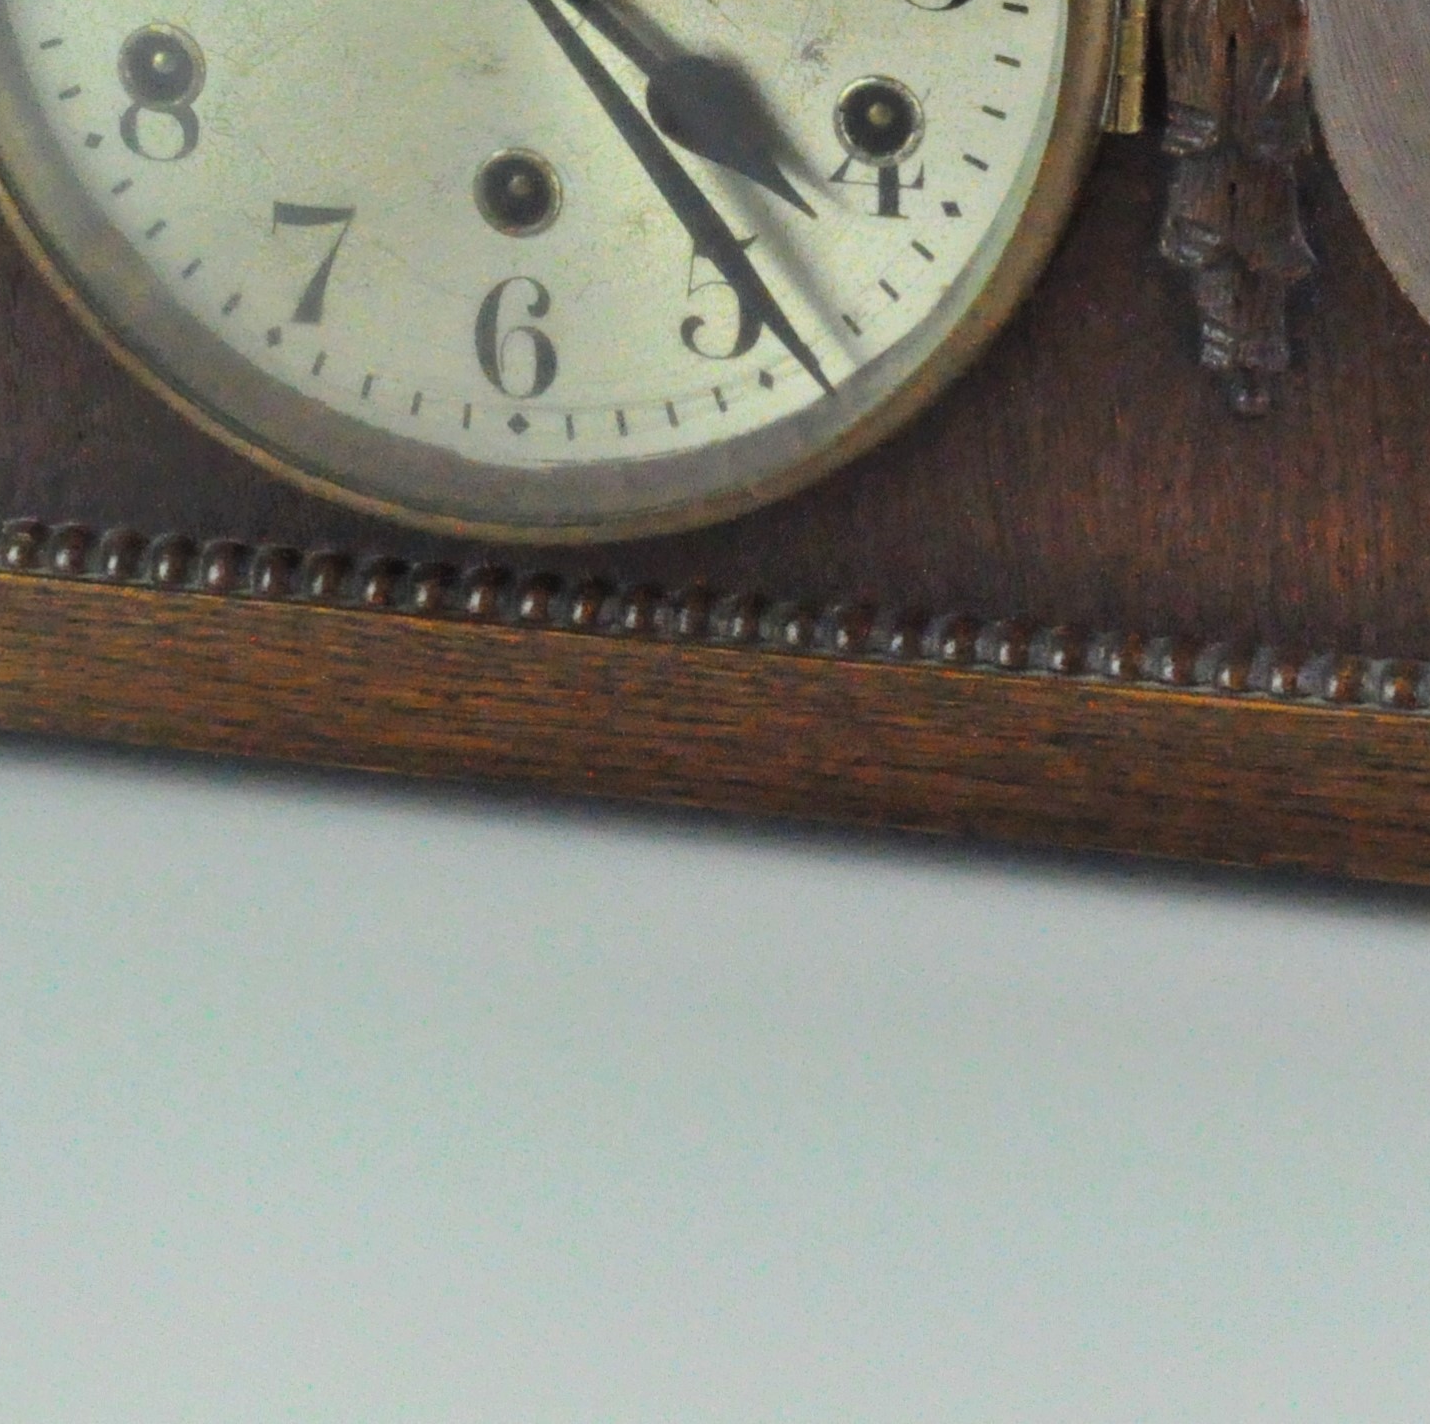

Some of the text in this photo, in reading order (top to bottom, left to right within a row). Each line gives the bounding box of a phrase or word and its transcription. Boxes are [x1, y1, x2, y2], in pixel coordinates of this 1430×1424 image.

[272, 201, 356, 325] 7
[680, 234, 759, 359] 5
[474, 276, 558, 398] 6
